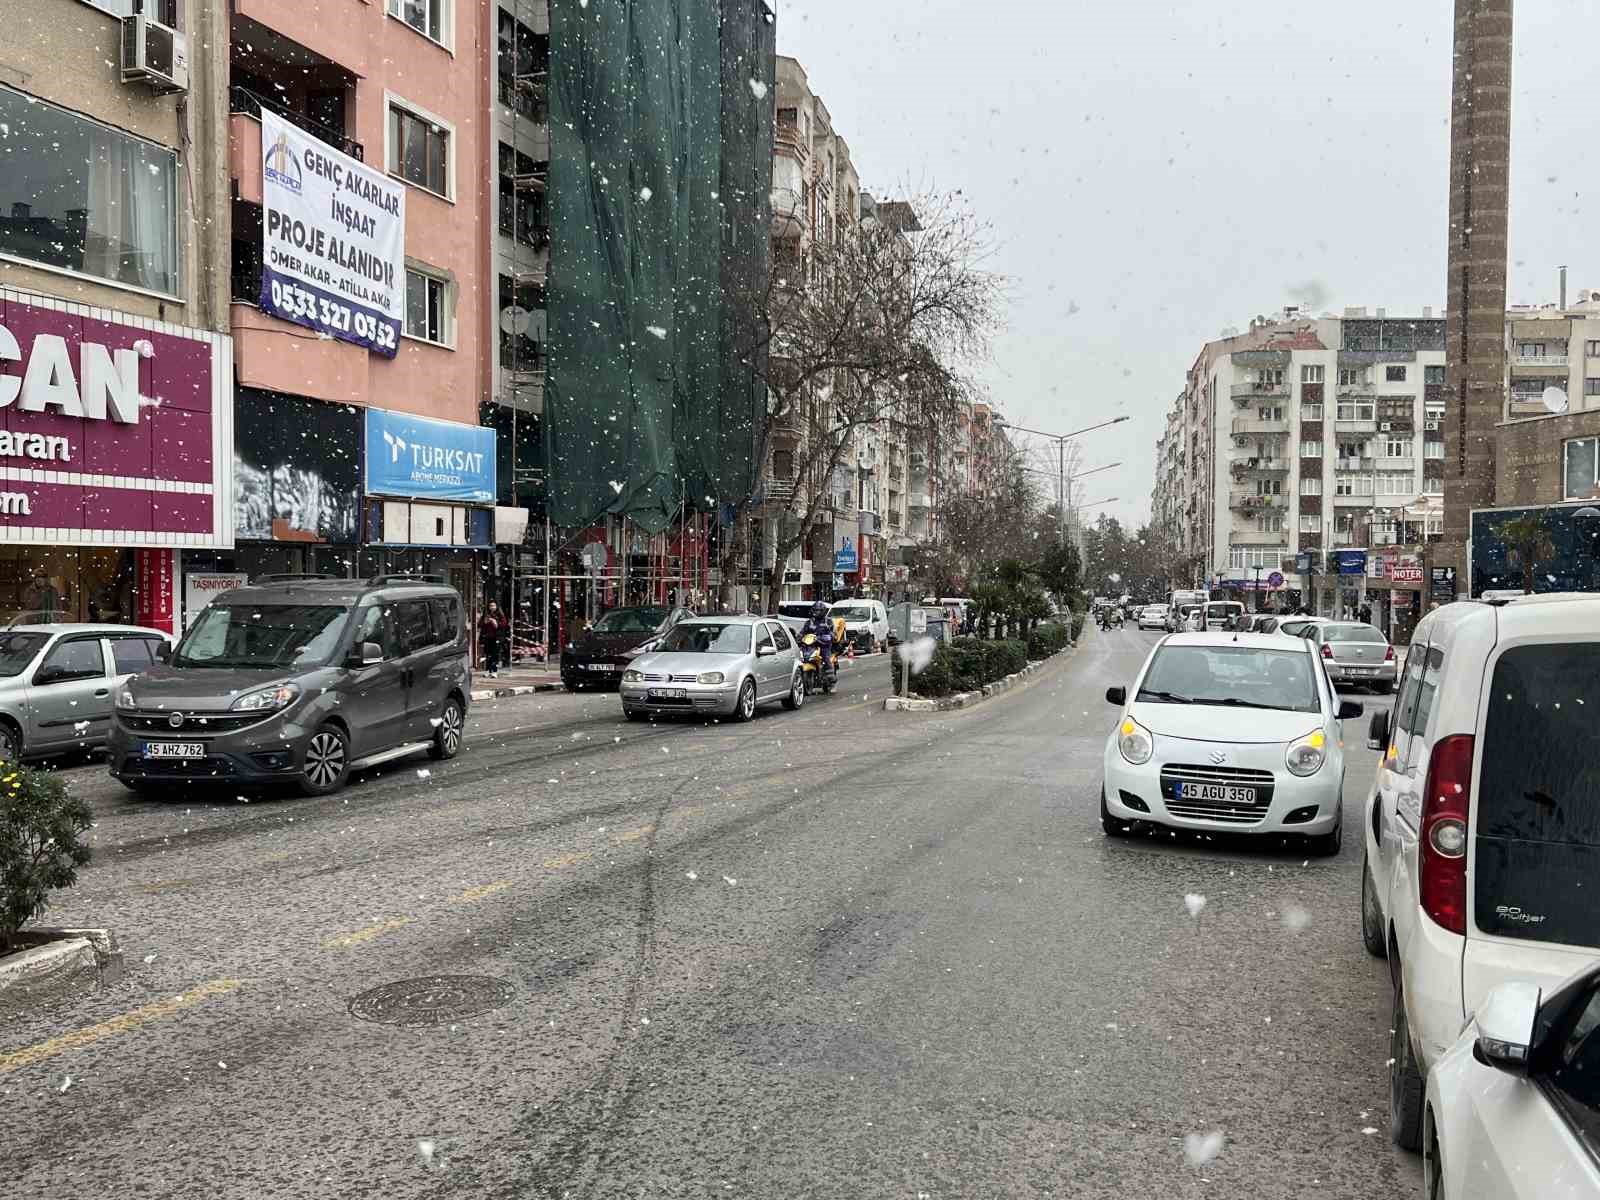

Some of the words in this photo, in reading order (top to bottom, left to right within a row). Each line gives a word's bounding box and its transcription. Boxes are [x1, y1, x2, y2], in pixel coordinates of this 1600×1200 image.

[304, 149, 343, 191] GENÇ
[345, 170, 400, 217] AKARLAR
[268, 208, 325, 257] PROJE
[331, 193, 376, 239] İNŞAAT
[270, 246, 302, 276] ÖMER
[303, 262, 331, 286] AKAR
[338, 275, 369, 300] ATİLLA
[271, 280, 318, 319] 0533
[318, 299, 350, 331] 327
[354, 314, 396, 350] 0352
[1393, 569, 1422, 579] NOTER
[147, 743, 160, 755] 45
[162, 744, 181, 756] AHZ
[183, 744, 202, 756] 762
[1182, 784, 1198, 797] 45
[1201, 786, 1226, 800] AGU
[1229, 788, 1254, 802] 350
